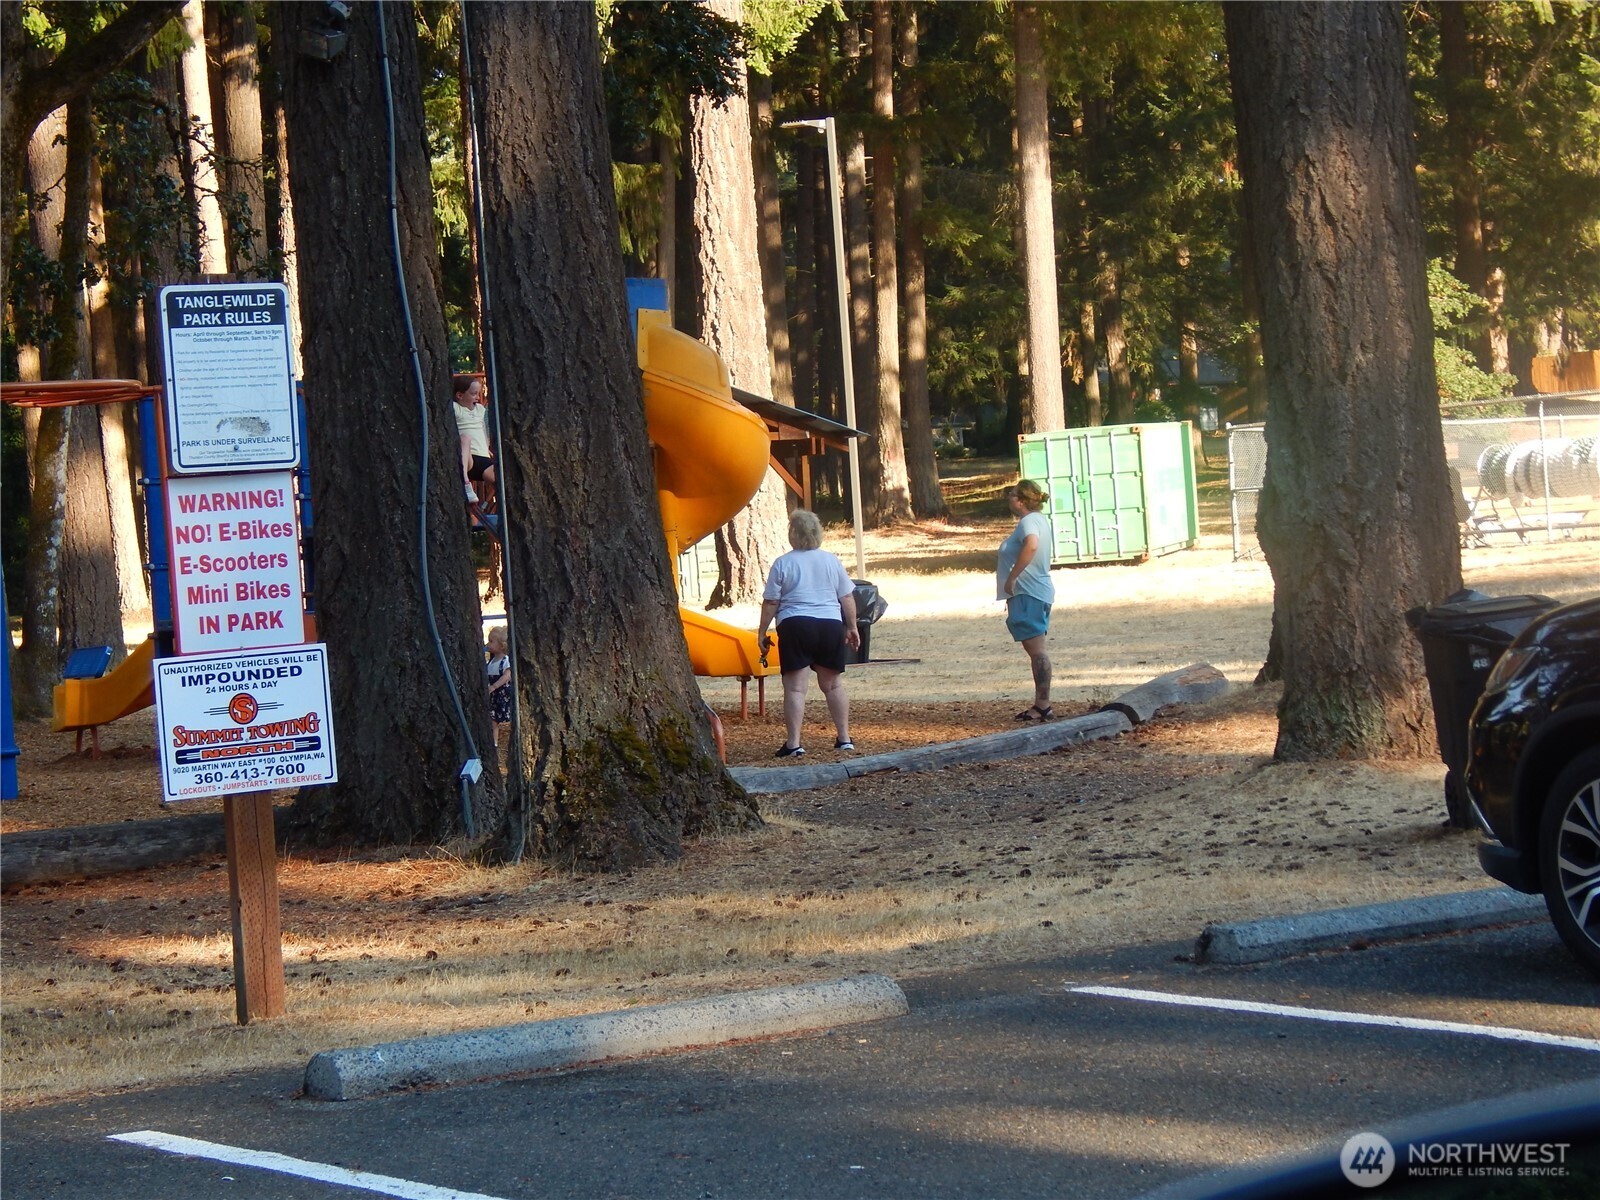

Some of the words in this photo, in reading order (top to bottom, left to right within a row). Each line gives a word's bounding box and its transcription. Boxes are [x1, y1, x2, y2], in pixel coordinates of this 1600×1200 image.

[176, 294, 275, 309] TANGLEWILDE
[183, 312, 222, 326] PARK
[225, 311, 271, 325] RULES
[181, 440, 201, 448] PARK
[211, 437, 237, 446] UNDER
[237, 435, 291, 445] SURVEILLANCE
[178, 489, 284, 514] WARNING!
[175, 524, 212, 544] NO!
[219, 519, 293, 542] E-Bikes
[179, 551, 288, 575] E-Scooters
[187, 583, 229, 605] Mini
[235, 580, 291, 602] Bikes
[199, 615, 220, 635] IN
[227, 609, 284, 633] PARK
[163, 662, 233, 675] UNAUTHORIZED
[235, 657, 280, 668] VEHICLES
[281, 655, 304, 664] WILL
[306, 654, 318, 662] BE
[181, 665, 303, 688] IMPOUNDED
[205, 686, 216, 694] 24
[218, 683, 250, 693] HOURS
[260, 680, 278, 688] DAY
[200, 740, 296, 760] NORTH
[172, 765, 190, 775] 9020
[191, 763, 219, 772] MARTIN
[220, 760, 236, 768] WAY
[238, 759, 256, 767] EAST
[194, 762, 305, 785] 360-413-7600
[179, 784, 217, 796] LOCKOUTS
[222, 779, 268, 791] JUMPSTARTS
[274, 776, 291, 784] TIRE
[292, 773, 322, 783] SERVICE
